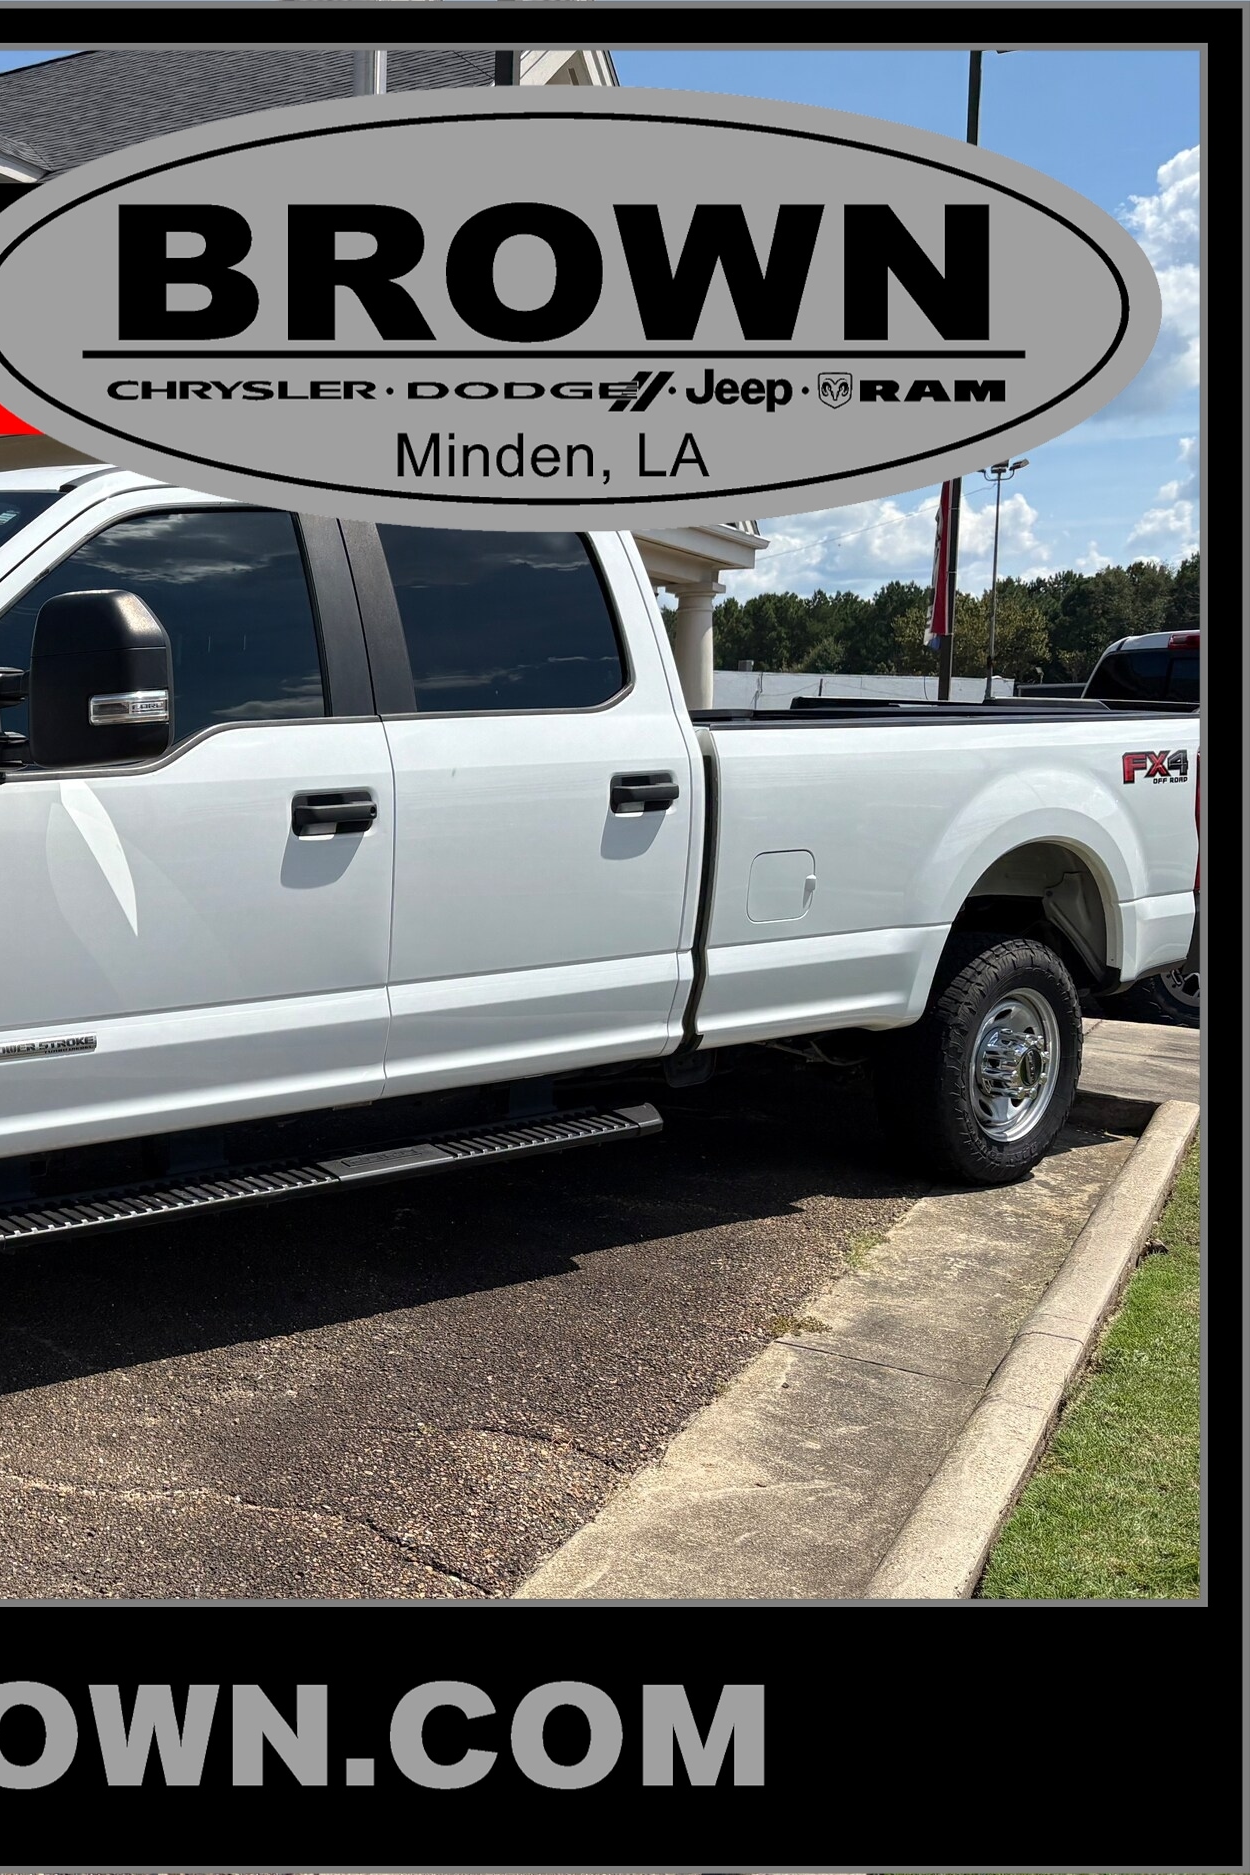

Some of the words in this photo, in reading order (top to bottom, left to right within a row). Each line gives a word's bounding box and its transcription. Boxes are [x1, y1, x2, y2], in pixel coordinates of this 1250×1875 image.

[1122, 749, 1189, 785] FX4
[1152, 777, 1168, 785] OFF
[1169, 776, 1189, 784] ROAD
[39, 1036, 95, 1051] STROKE
